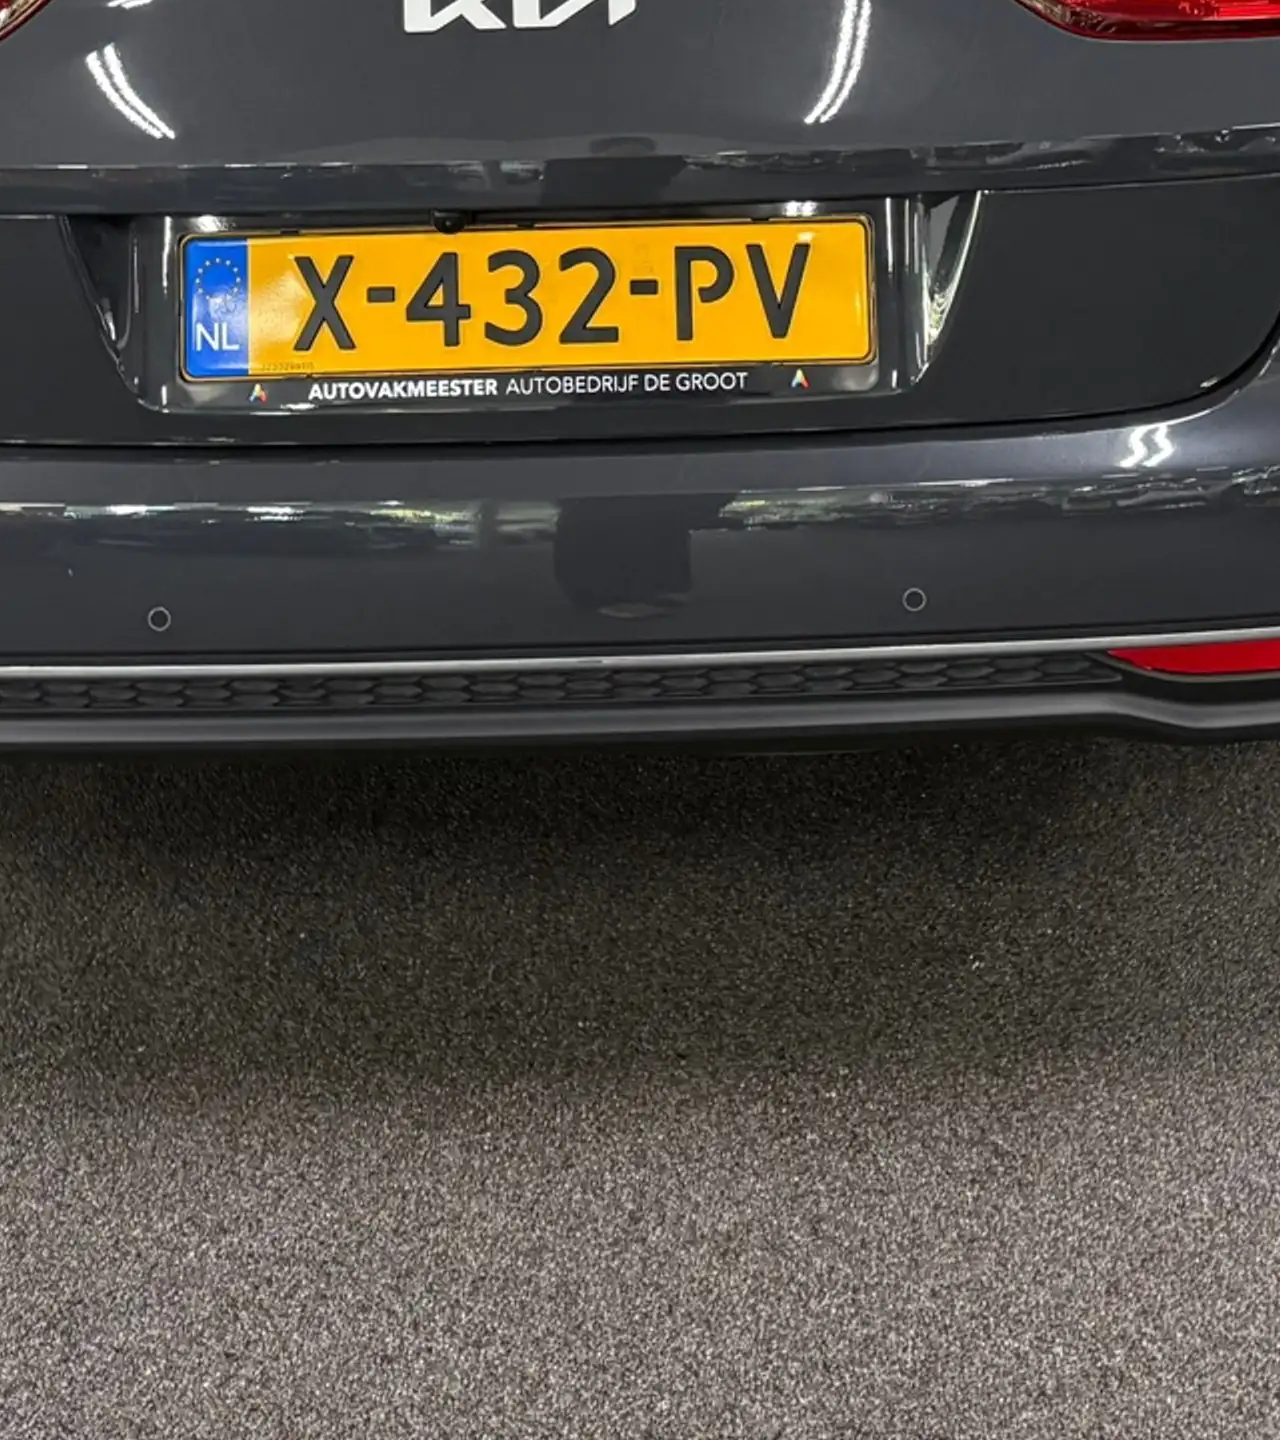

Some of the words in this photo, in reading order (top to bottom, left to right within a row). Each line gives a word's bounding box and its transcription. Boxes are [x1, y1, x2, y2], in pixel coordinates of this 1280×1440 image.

[293, 243, 811, 351] X-432-PV
[195, 322, 240, 351] NL
[308, 379, 498, 401] AUTOVAKMEESTER
[505, 374, 640, 396] AUTOBEDRIJF
[644, 373, 672, 392] DE
[676, 371, 749, 392] GROOT
